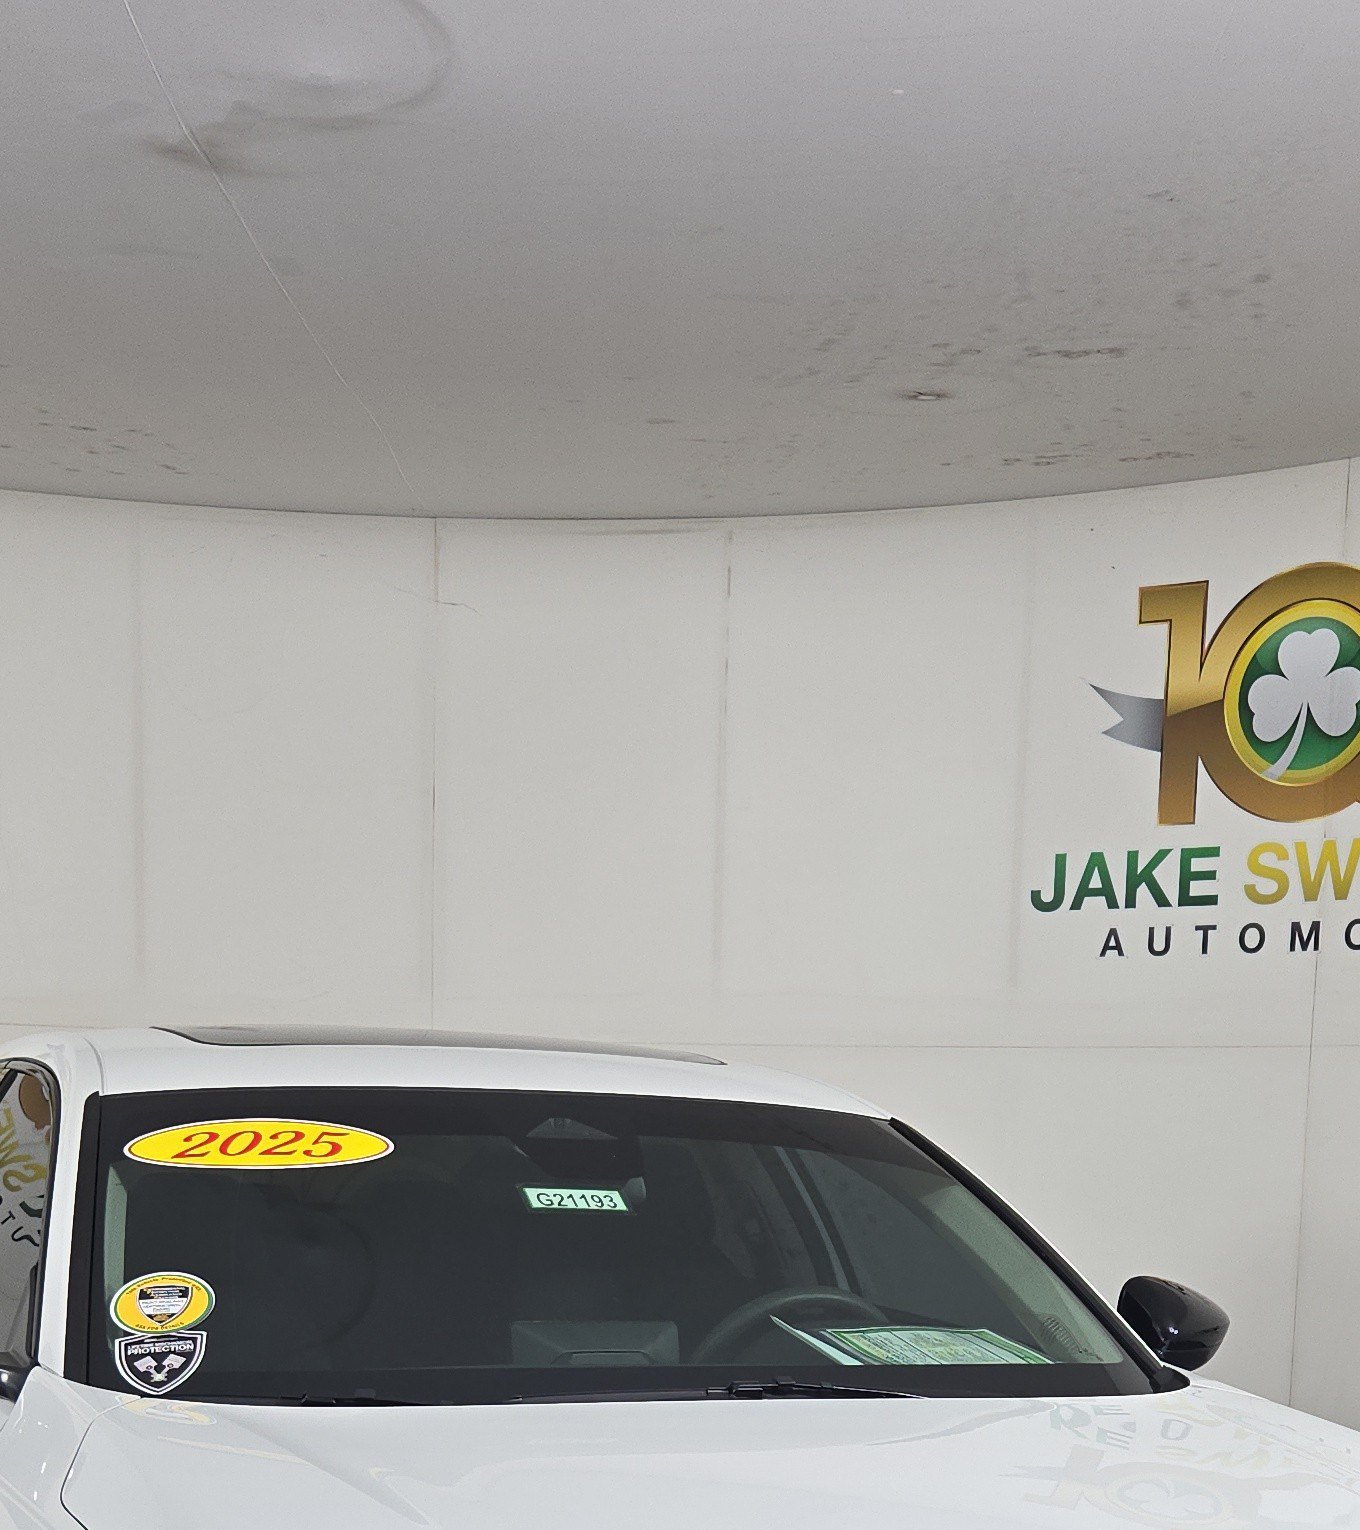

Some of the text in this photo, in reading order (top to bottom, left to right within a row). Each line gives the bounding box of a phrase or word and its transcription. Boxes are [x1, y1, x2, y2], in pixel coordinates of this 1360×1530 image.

[1030, 845, 1221, 912] JAKE
[170, 1130, 350, 1160] 2025
[536, 1192, 618, 1209] G21193
